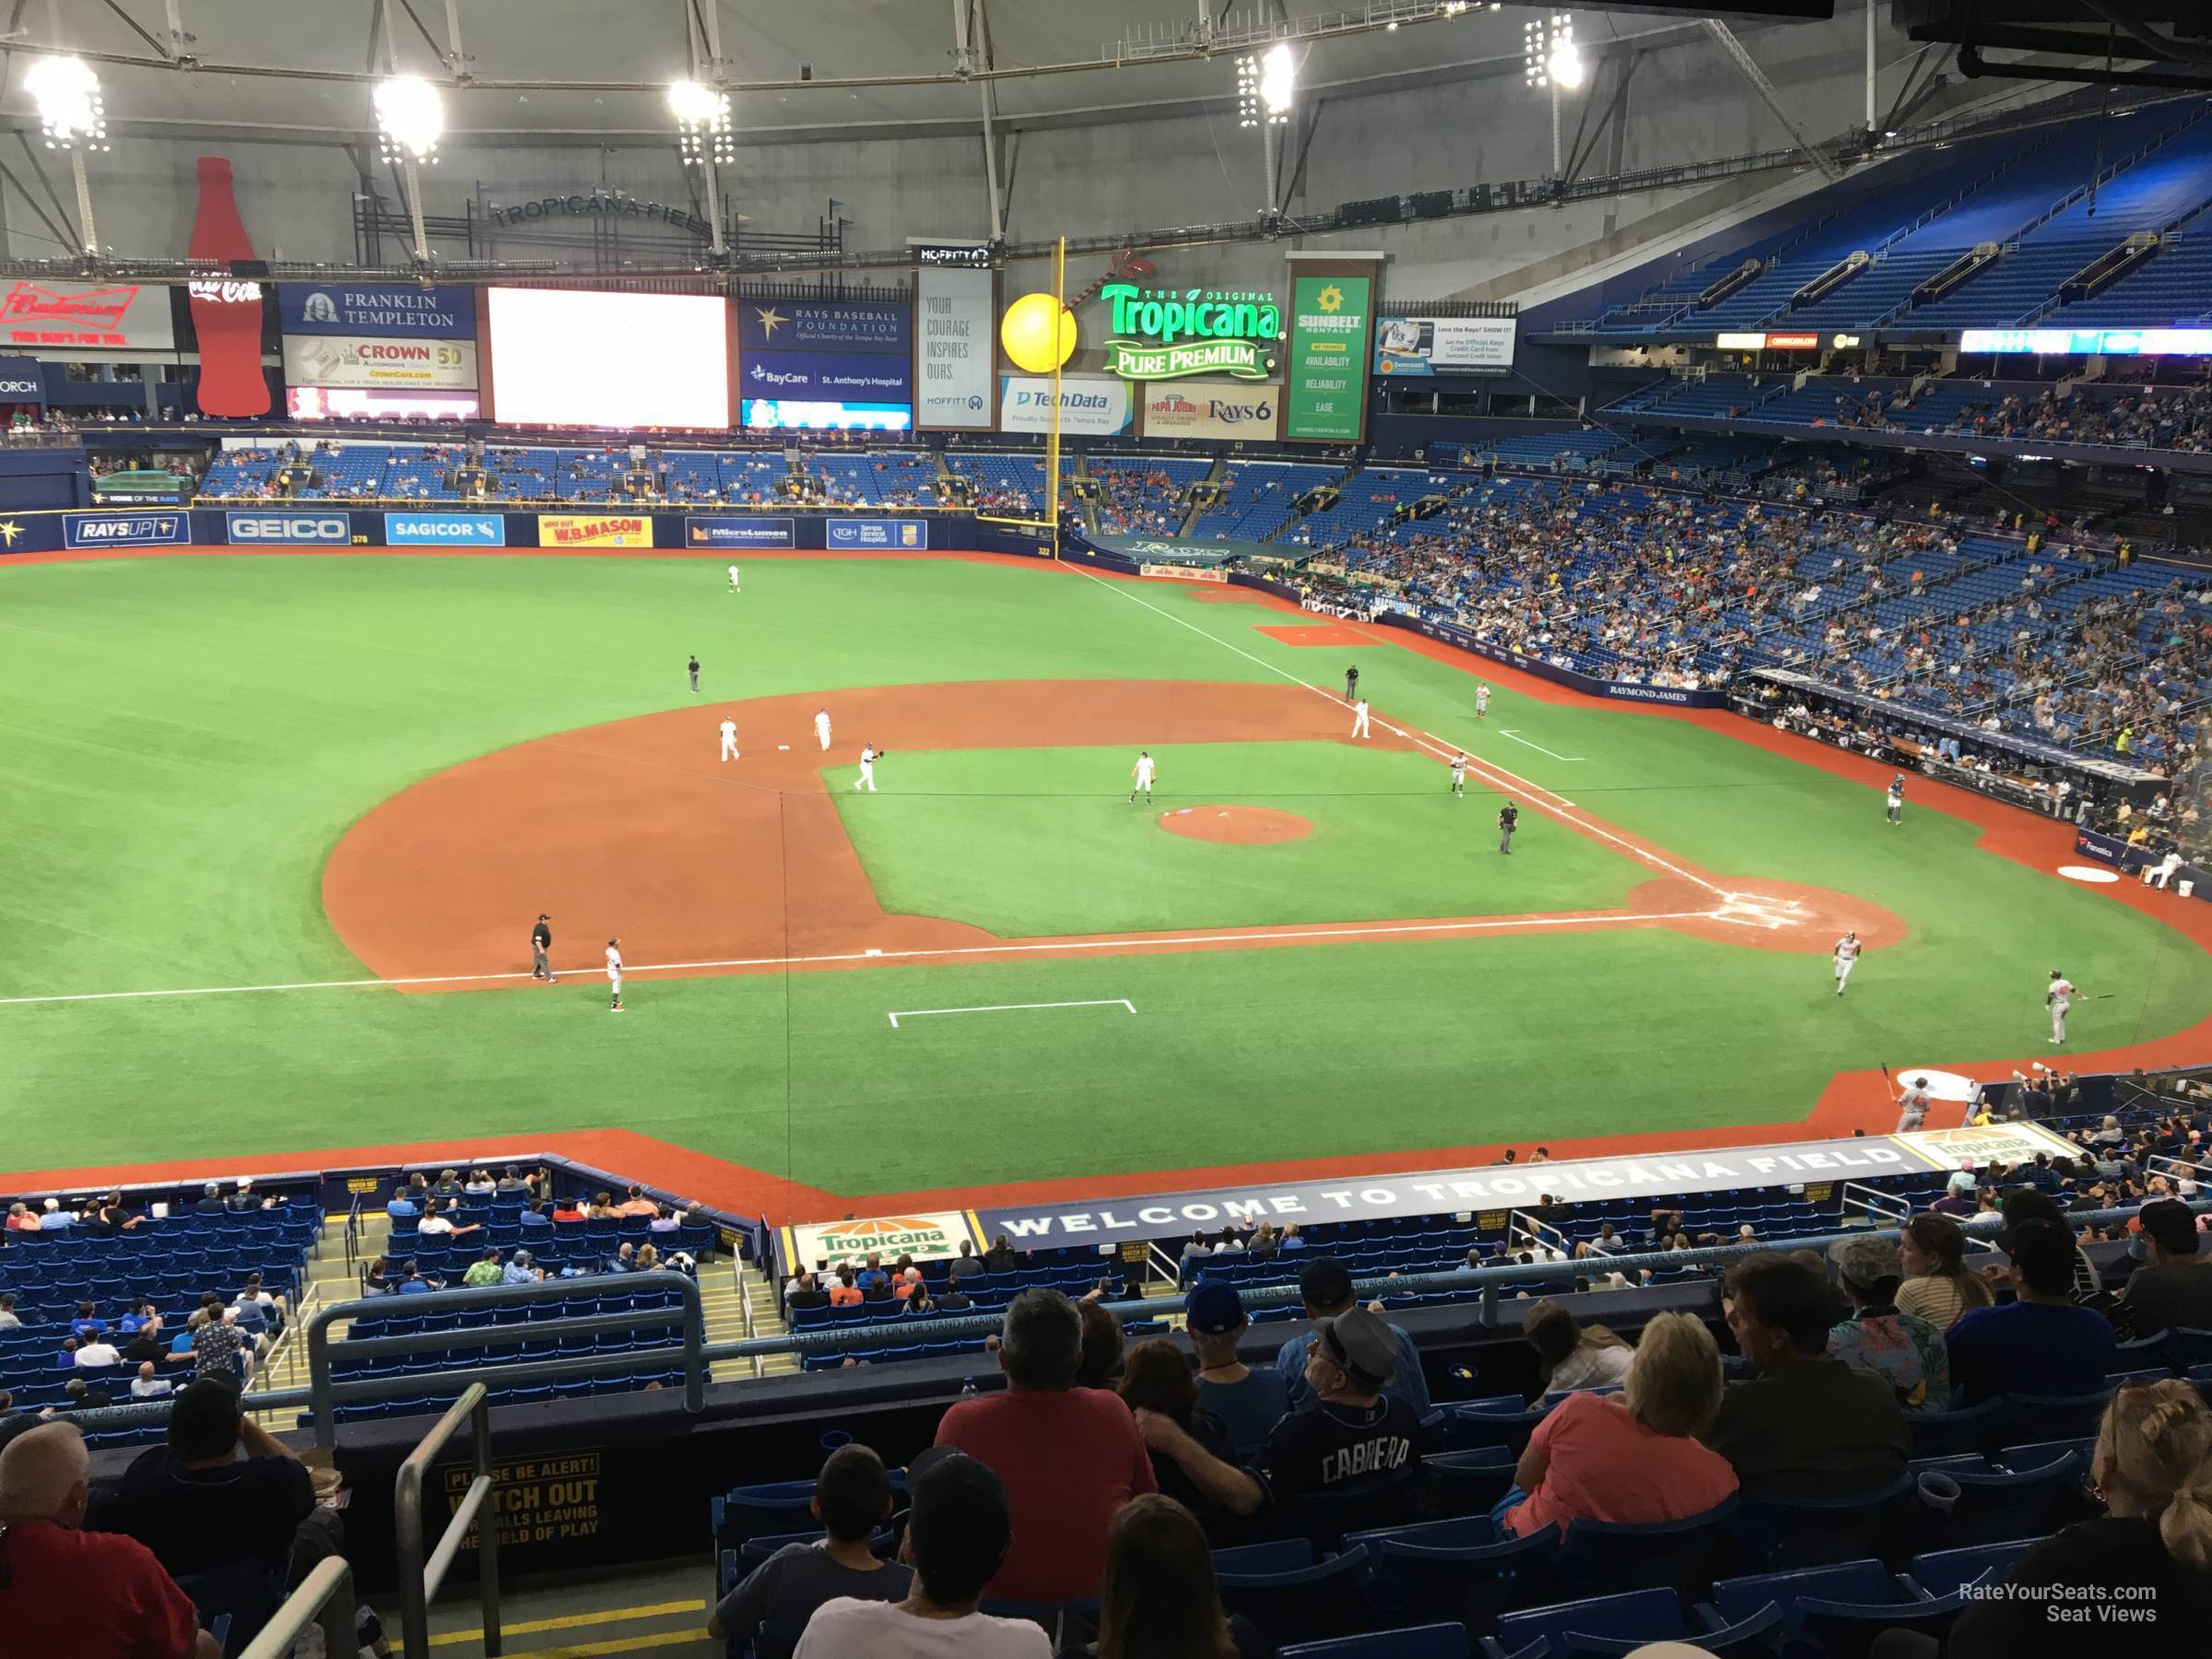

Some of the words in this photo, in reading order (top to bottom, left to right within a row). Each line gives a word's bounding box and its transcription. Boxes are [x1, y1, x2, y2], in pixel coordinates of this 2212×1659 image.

[490, 195, 640, 228] TROPICANA
[345, 293, 437, 309] FRANKLIN
[1145, 290, 1178, 299] THE
[1206, 291, 1274, 301] ORIGINAL
[926, 297, 951, 314] YOUR
[1100, 284, 1279, 342] Tropicana
[345, 311, 454, 326] TEMPLETON
[796, 310, 828, 319] RAYS
[834, 311, 899, 322] BASEBALL
[1298, 314, 1361, 328] SUNBELT
[796, 321, 897, 332] FOUNDATION
[926, 319, 970, 337] COURAGE
[359, 345, 430, 360] CROWN
[437, 347, 462, 364] 50
[926, 341, 968, 359] INSPIRES
[1119, 350, 1167, 373] PURE
[1170, 346, 1255, 369] PREMIUM
[1305, 357, 1350, 367] AVAILABILITY
[767, 372, 808, 385] BayCare
[926, 363, 955, 381] OURS.
[822, 375, 833, 383] St.
[834, 376, 871, 387] Anthony's
[871, 377, 902, 387] Hospital
[1305, 379, 1347, 390] RELIABILITY
[926, 396, 967, 406] MOFFITT
[1071, 394, 1108, 408] Data
[1315, 402, 1334, 413] EASE
[1255, 401, 1271, 420] 6
[232, 519, 346, 538] GEICO
[394, 522, 473, 536] SAGICOR
[712, 528, 788, 536] MicroLumen
[1610, 686, 1655, 698] RAYMOND
[1656, 691, 1687, 701] JAMES
[2087, 841, 2112, 857] Fanatics
[1925, 1136, 2032, 1155] Tropicana
[999, 1195, 1308, 1237] WELCOME
[1321, 1188, 1397, 1208] TO
[1413, 1161, 1740, 1200] TROPICANA
[1747, 1147, 1902, 1174] FIELD
[817, 1230, 945, 1251] Tropicana
[790, 1335, 806, 1346] DO
[908, 1323, 923, 1334] OR
[925, 1318, 961, 1332] STAND
[516, 1464, 535, 1478] BE
[541, 1458, 594, 1477] ALERT!
[1323, 1436, 1410, 1484] CABRERA
[449, 1485, 540, 1517] WTCH
[549, 1479, 598, 1506] OUT
[495, 1512, 531, 1528] ALLS
[536, 1504, 597, 1524] LEAVING
[461, 1535, 479, 1550] HE
[498, 1529, 529, 1545] IELD
[535, 1526, 554, 1541] OF
[560, 1521, 598, 1537] PLAY
